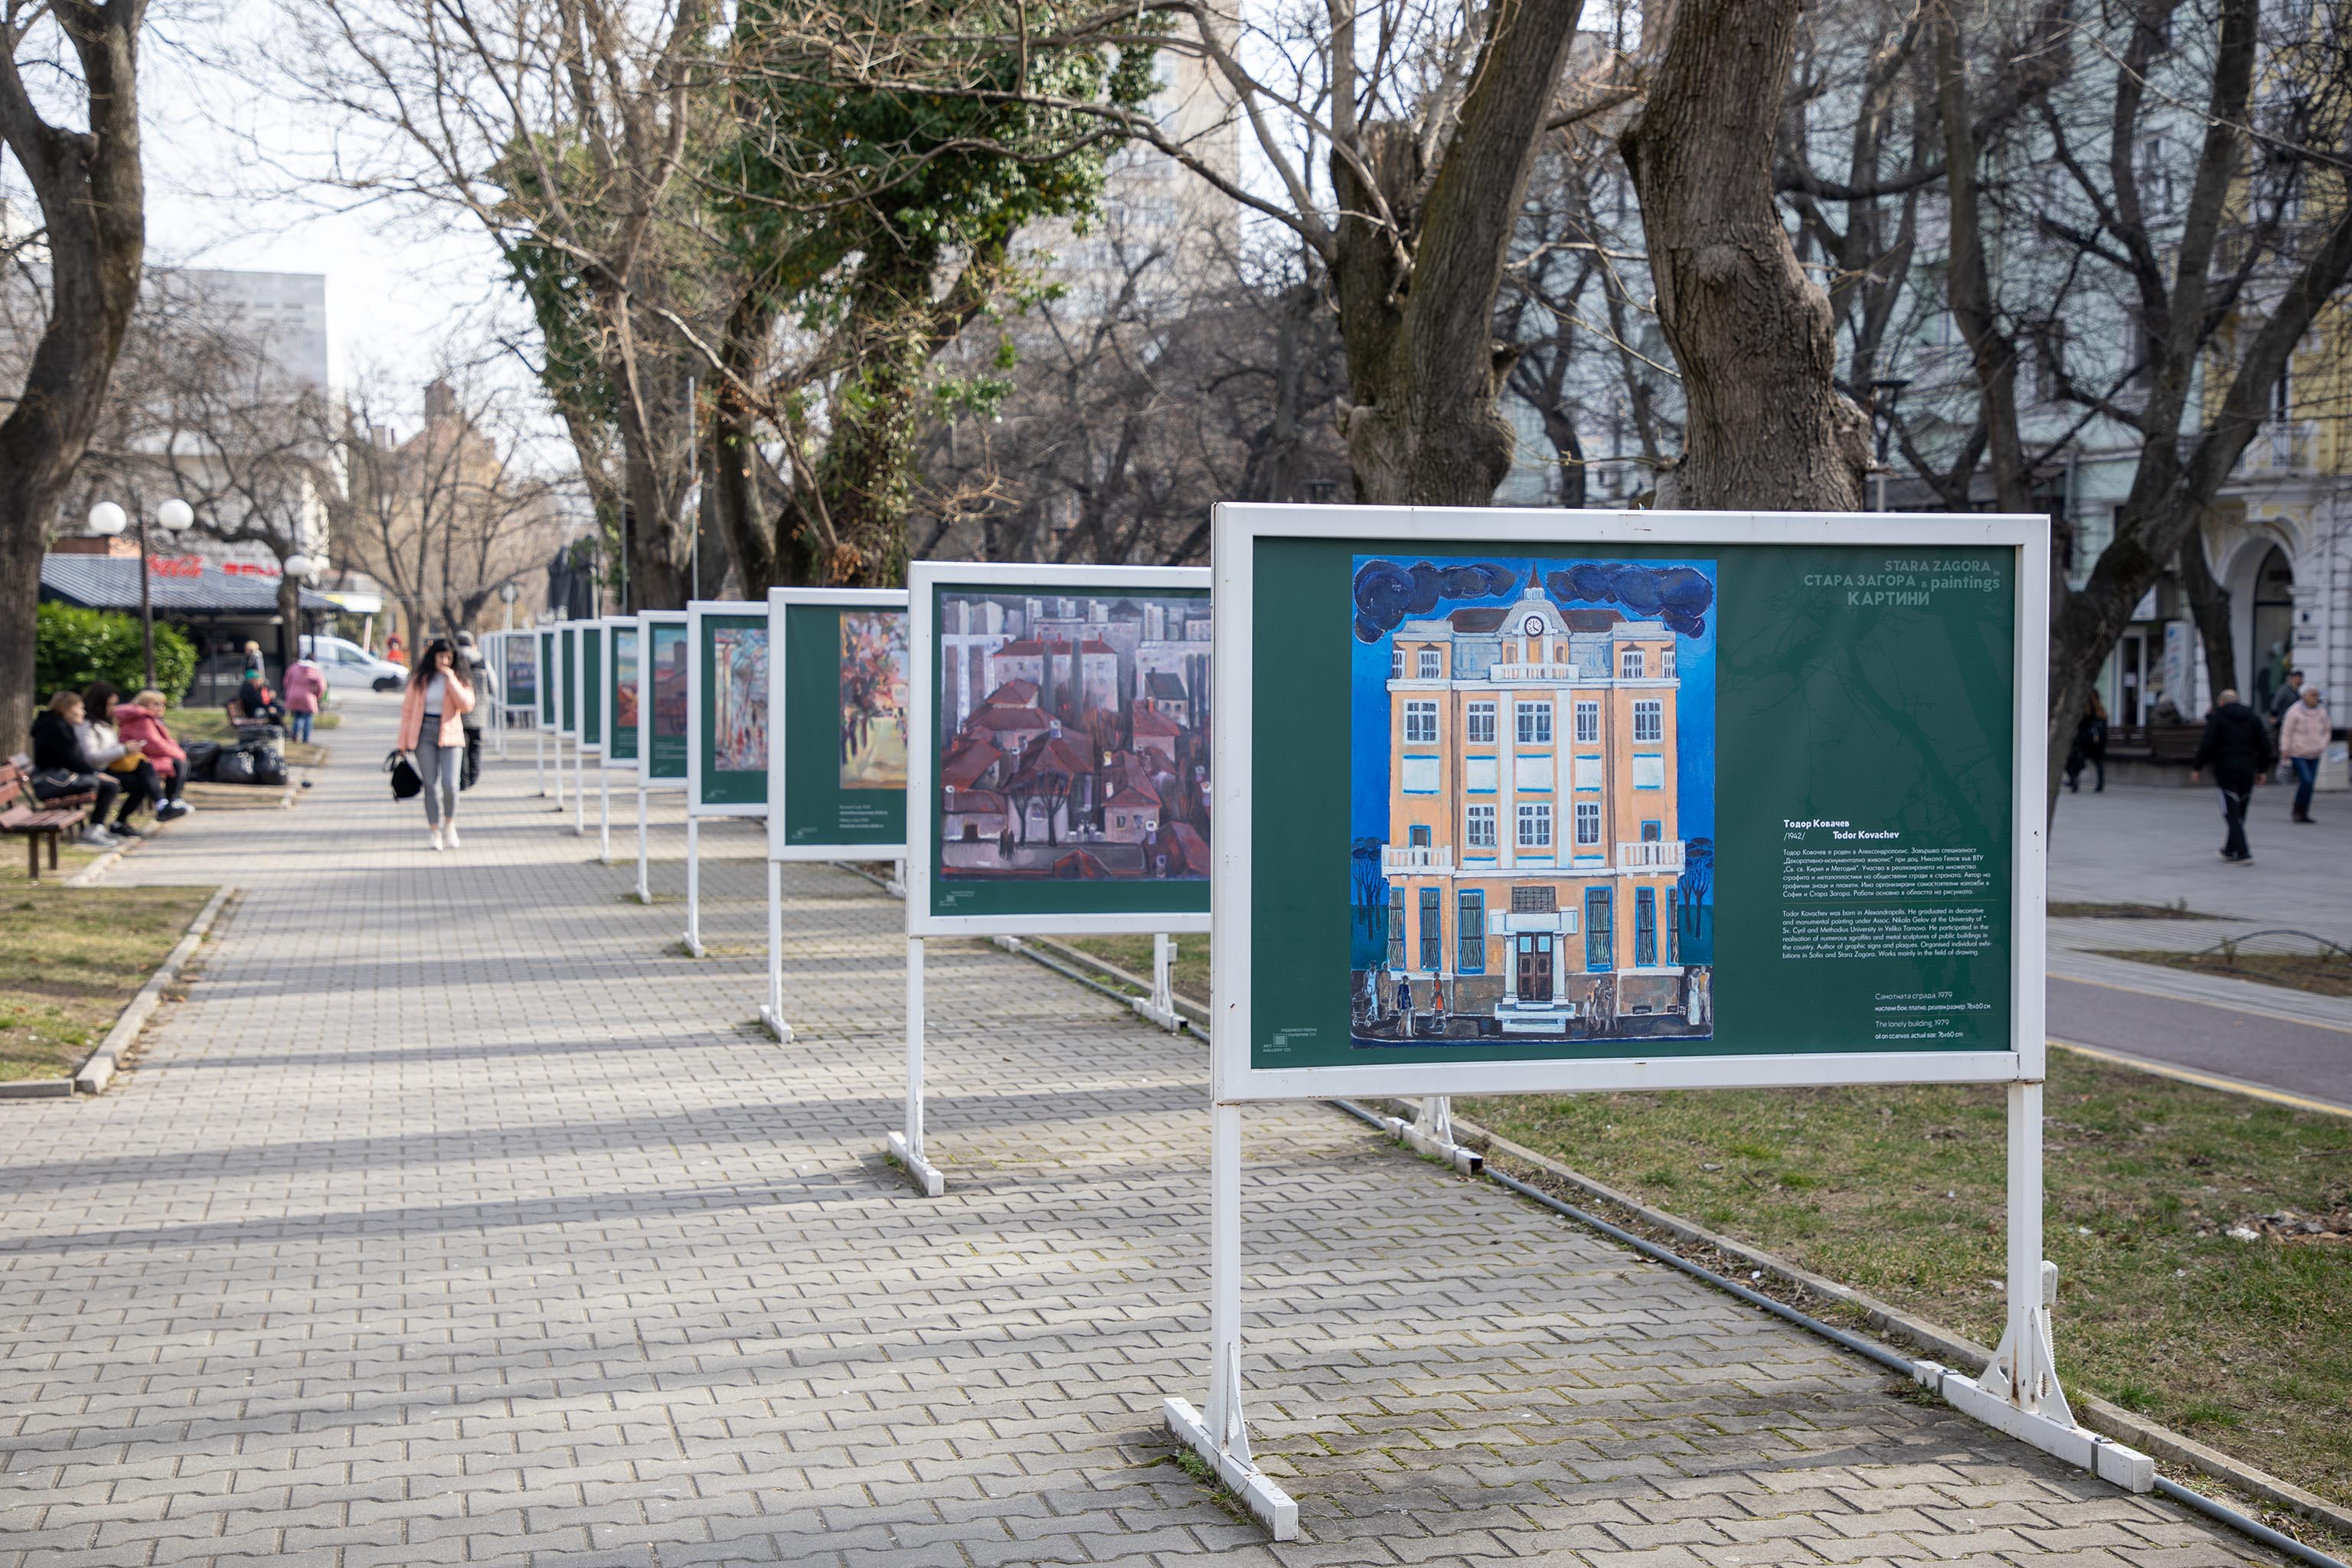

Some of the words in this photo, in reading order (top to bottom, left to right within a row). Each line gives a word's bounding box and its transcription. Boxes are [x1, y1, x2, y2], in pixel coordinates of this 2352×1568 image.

[1884, 560, 1929, 572] STARA
[1932, 560, 1991, 572] ZAGORA
[1804, 574, 1852, 586] СТАРА
[1857, 574, 1916, 586] ЗАГОРА
[1931, 576, 2001, 592] paintings
[1847, 591, 1929, 606] КАРТИНИ
[1783, 819, 1811, 829] Тодор
[1813, 818, 1849, 827] Ковачев
[1832, 831, 1857, 839] Todor
[1858, 830, 1899, 838] Kovachev
[1963, 871, 1981, 880] Автор
[1917, 907, 1947, 916] graduated
[1920, 940, 1950, 949] Organised
